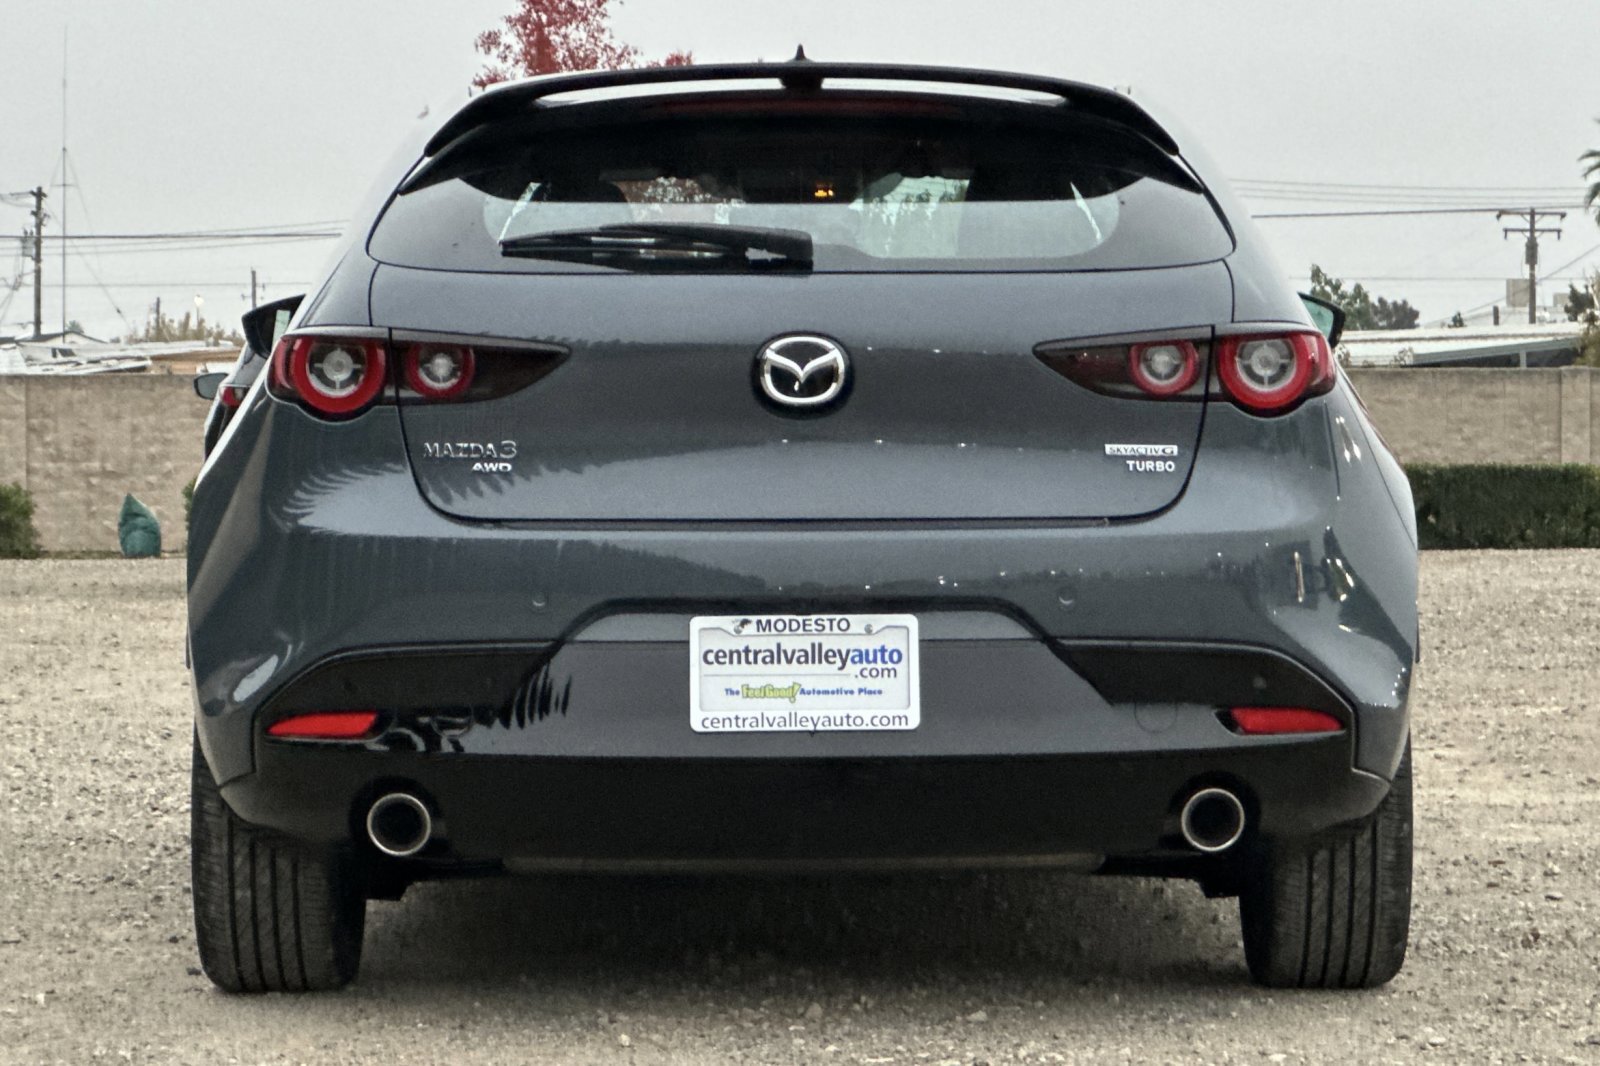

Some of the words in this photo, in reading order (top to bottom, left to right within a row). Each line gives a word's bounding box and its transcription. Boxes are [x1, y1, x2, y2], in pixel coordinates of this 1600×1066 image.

[472, 462, 512, 472] AWD
[1126, 460, 1175, 472] TURBO
[756, 618, 850, 632] MODESTO
[702, 642, 903, 670] centralvalleyauto
[854, 667, 897, 679] .com
[725, 688, 740, 696] The
[800, 688, 854, 696] Automotive
[858, 688, 883, 696] Place
[701, 712, 909, 729] centralvalleyauto.com
